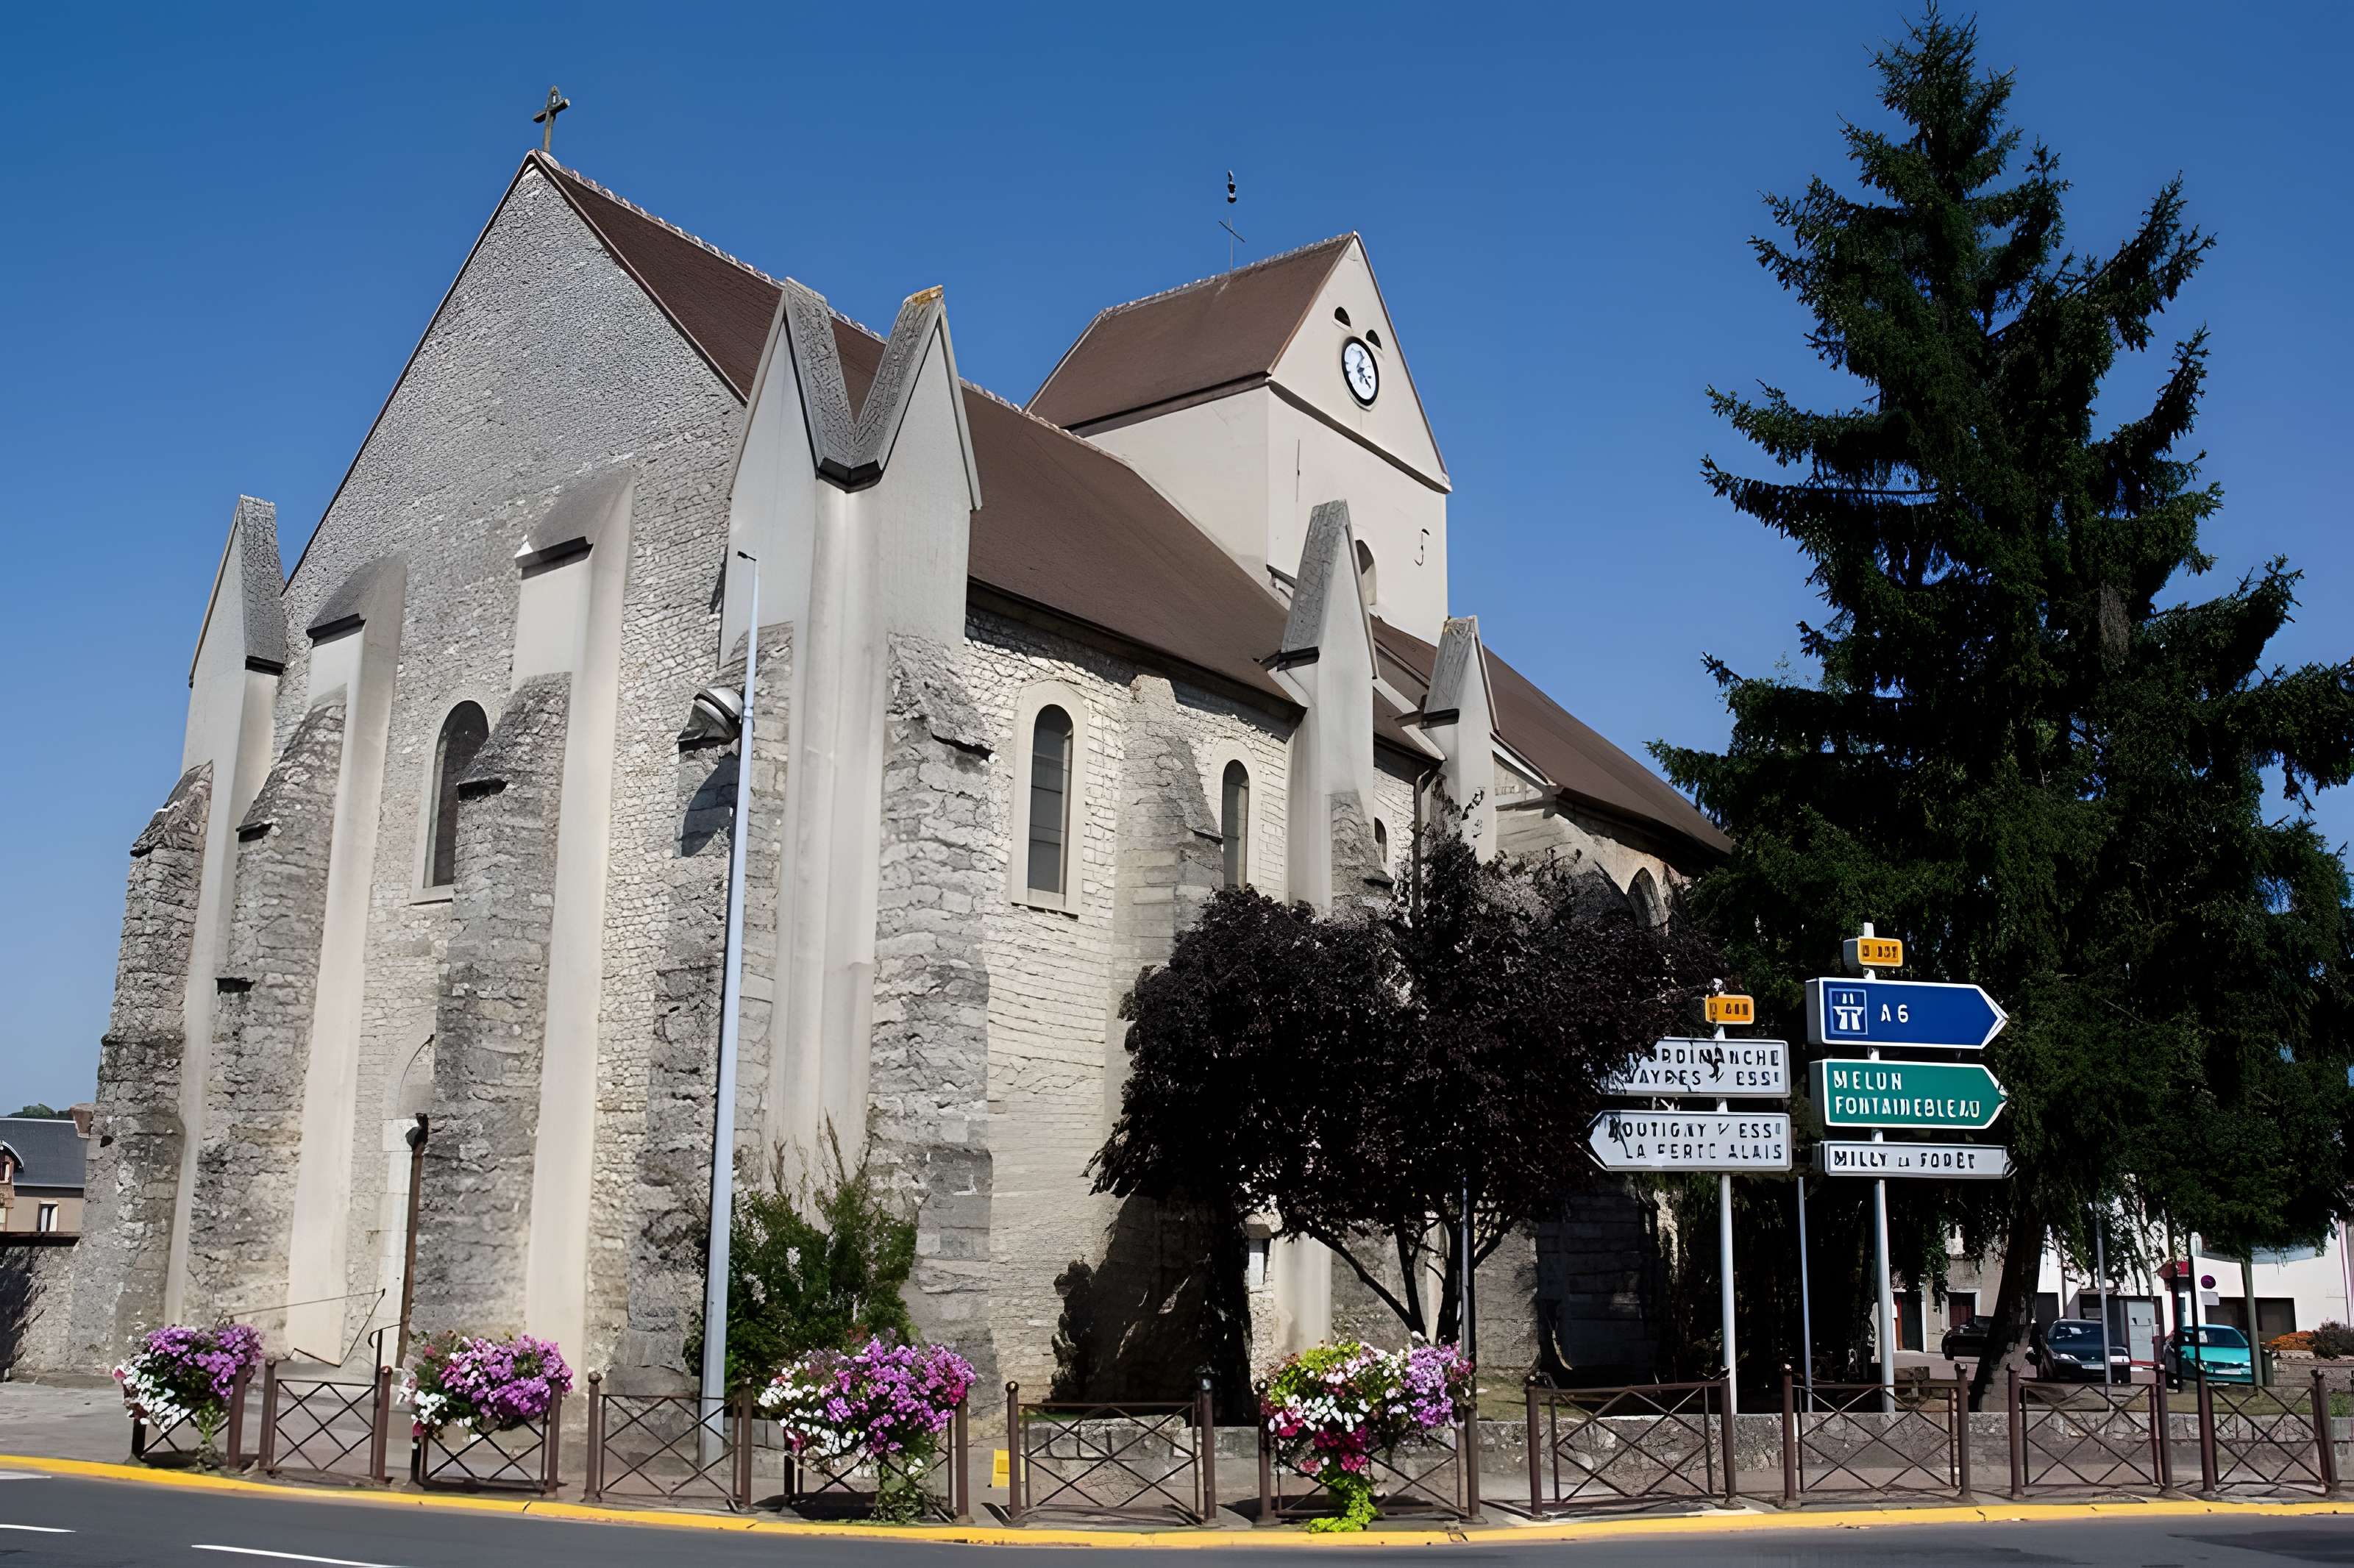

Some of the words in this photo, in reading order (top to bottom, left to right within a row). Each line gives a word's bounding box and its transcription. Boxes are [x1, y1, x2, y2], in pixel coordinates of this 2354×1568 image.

[1832, 1070, 1902, 1090] MELUN
[1835, 1095, 1980, 1118] FONTAINEBLEAU
[1834, 1150, 1888, 1167] MILLY
